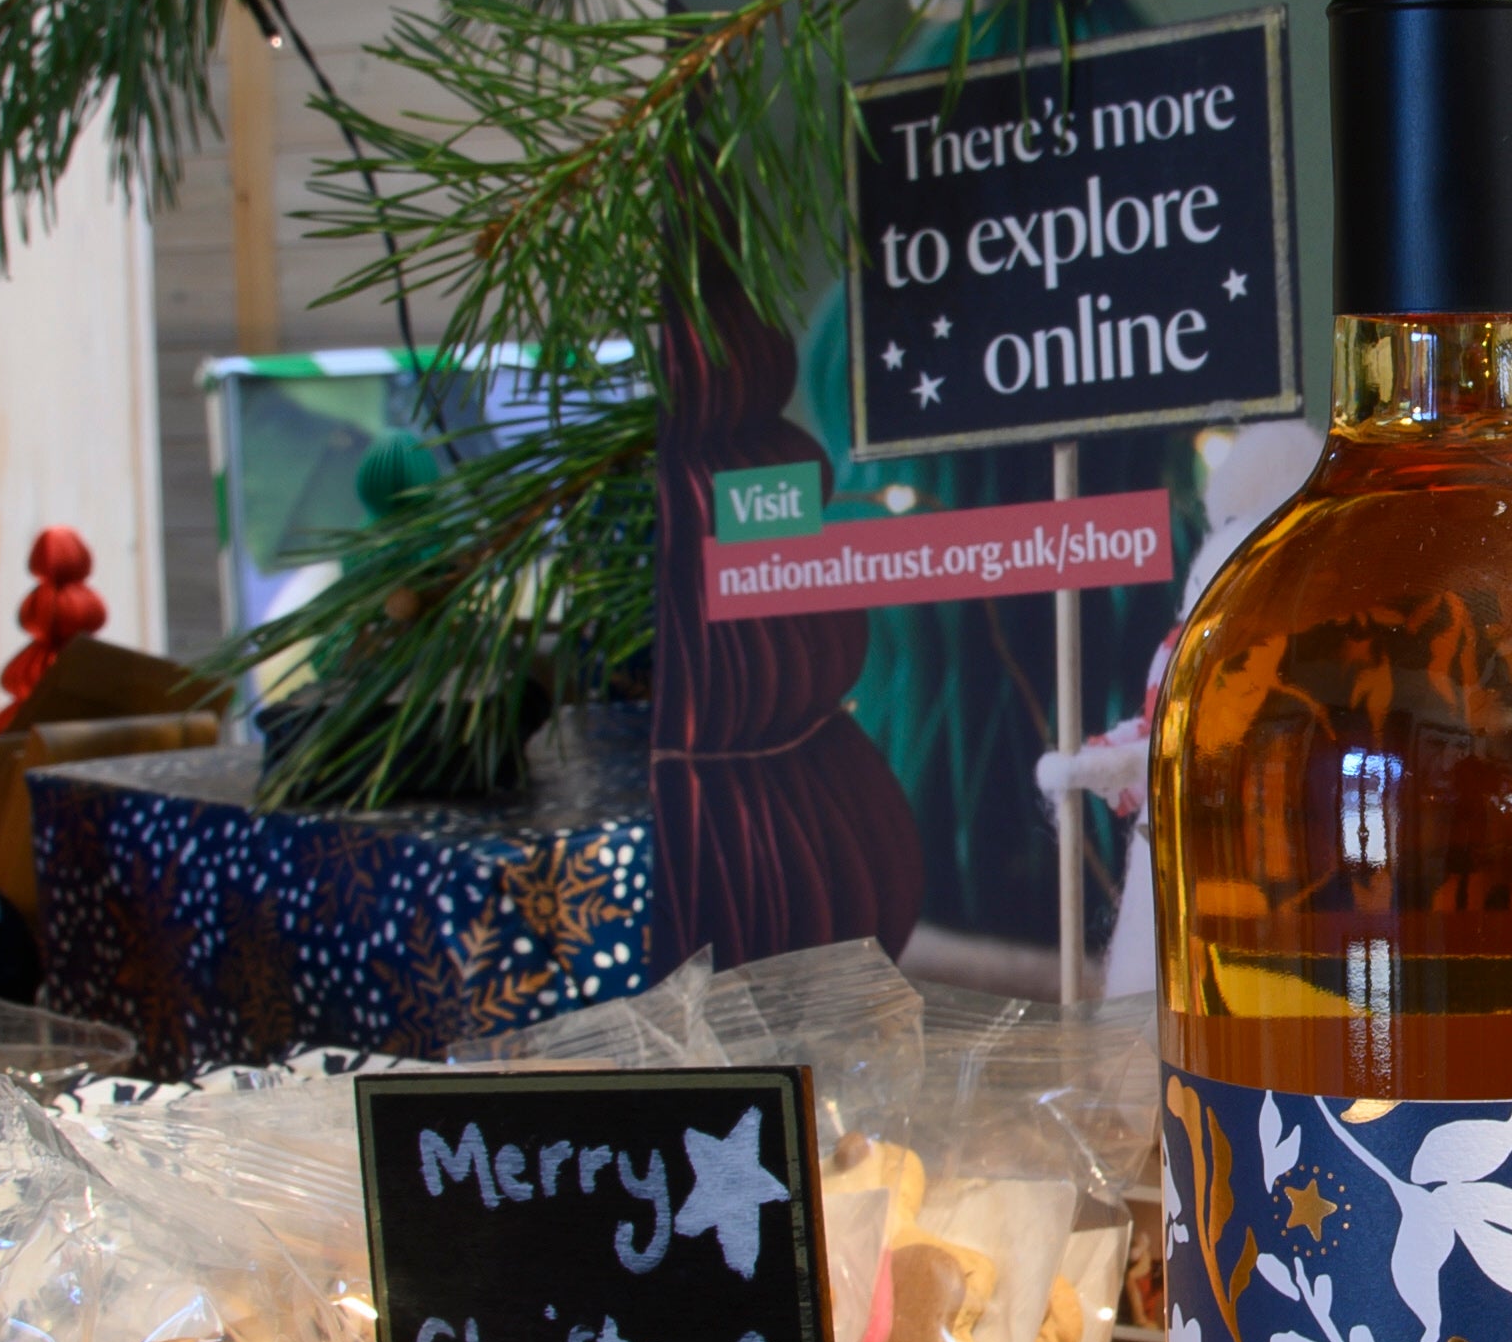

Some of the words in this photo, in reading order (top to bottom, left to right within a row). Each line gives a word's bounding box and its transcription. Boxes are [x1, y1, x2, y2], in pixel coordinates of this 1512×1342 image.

[891, 97, 1078, 181] There's
[1092, 84, 1236, 152] more
[882, 220, 949, 289] to
[967, 176, 1221, 290] explore
[984, 295, 1209, 395] online
[730, 483, 803, 525] Visit
[719, 519, 1158, 598] nationaltrust.org.uk/shop
[419, 1122, 672, 1274] Merry
